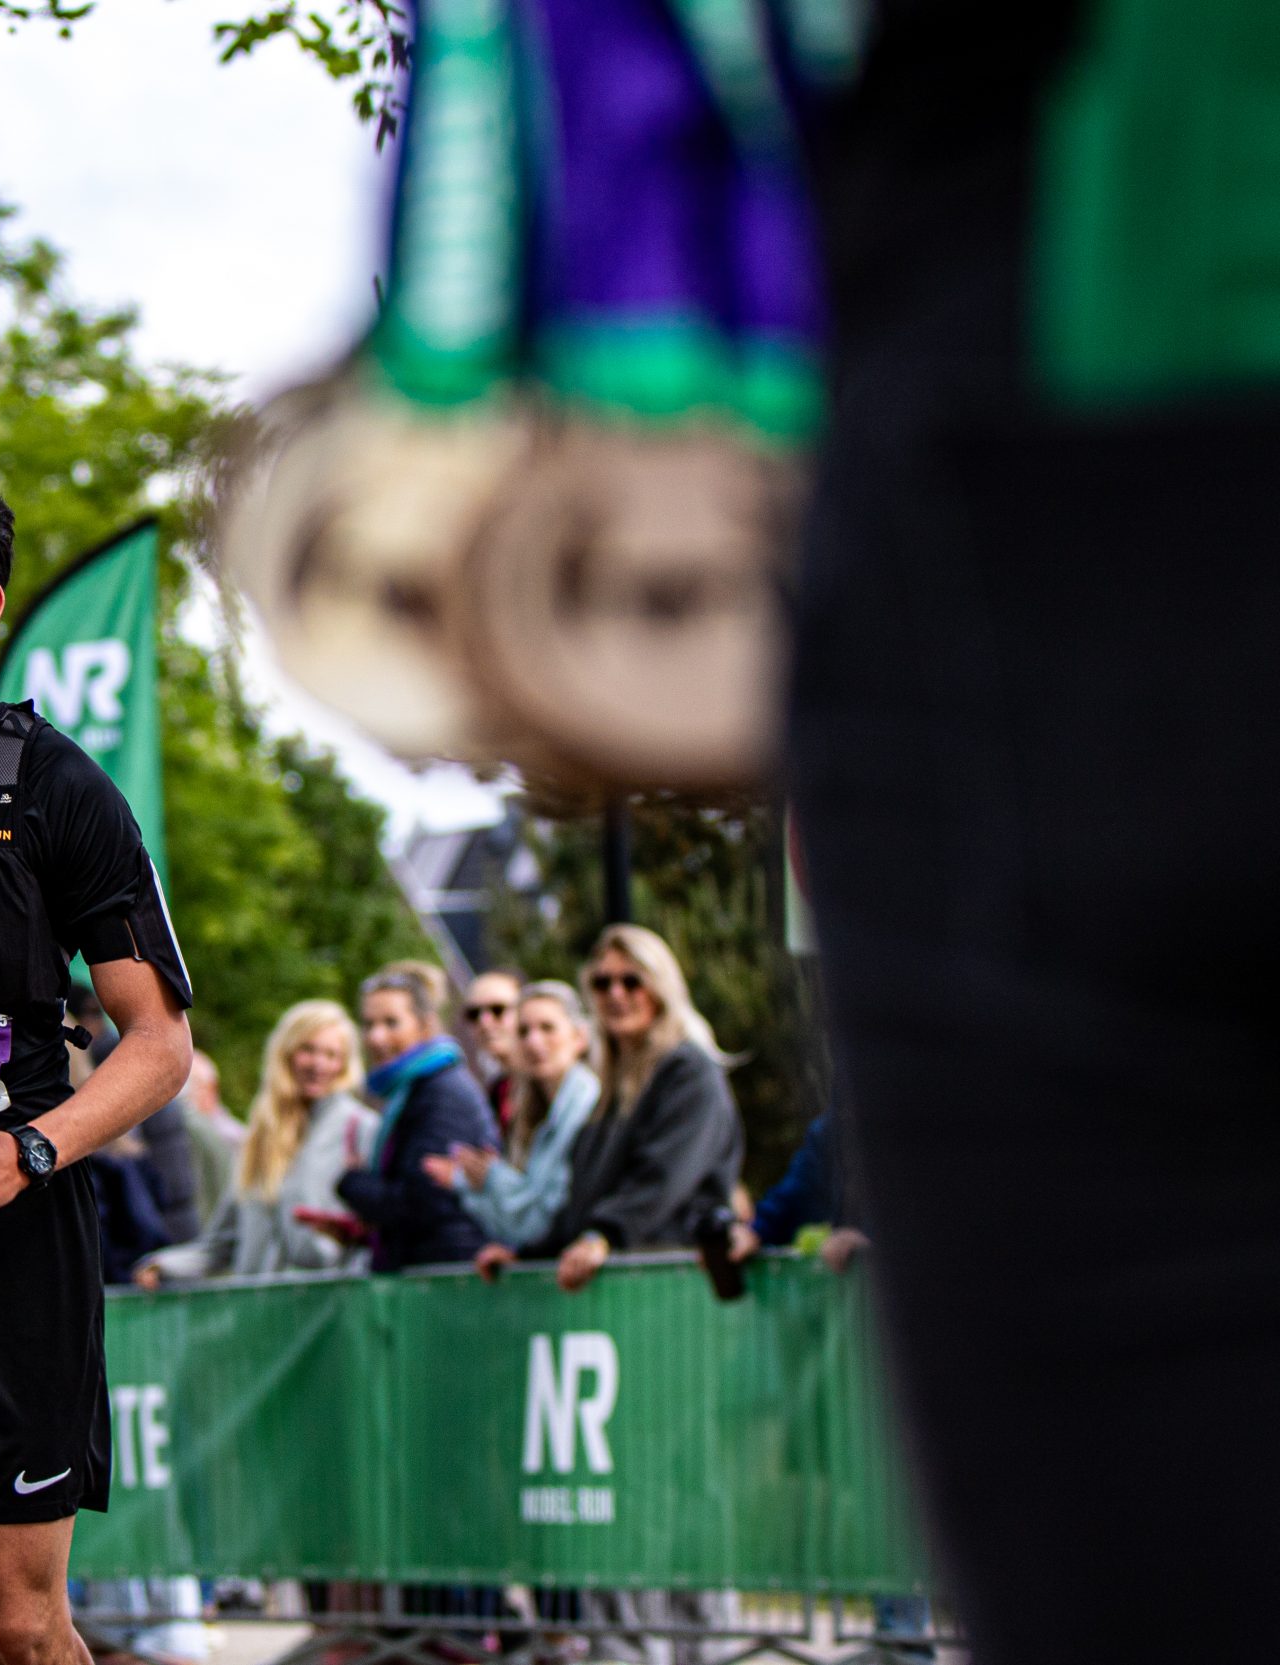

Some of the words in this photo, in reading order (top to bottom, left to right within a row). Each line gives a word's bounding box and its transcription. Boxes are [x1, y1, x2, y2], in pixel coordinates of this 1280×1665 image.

[22, 638, 131, 727] NR
[113, 1384, 170, 1490] TE
[523, 1330, 619, 1475] NR
